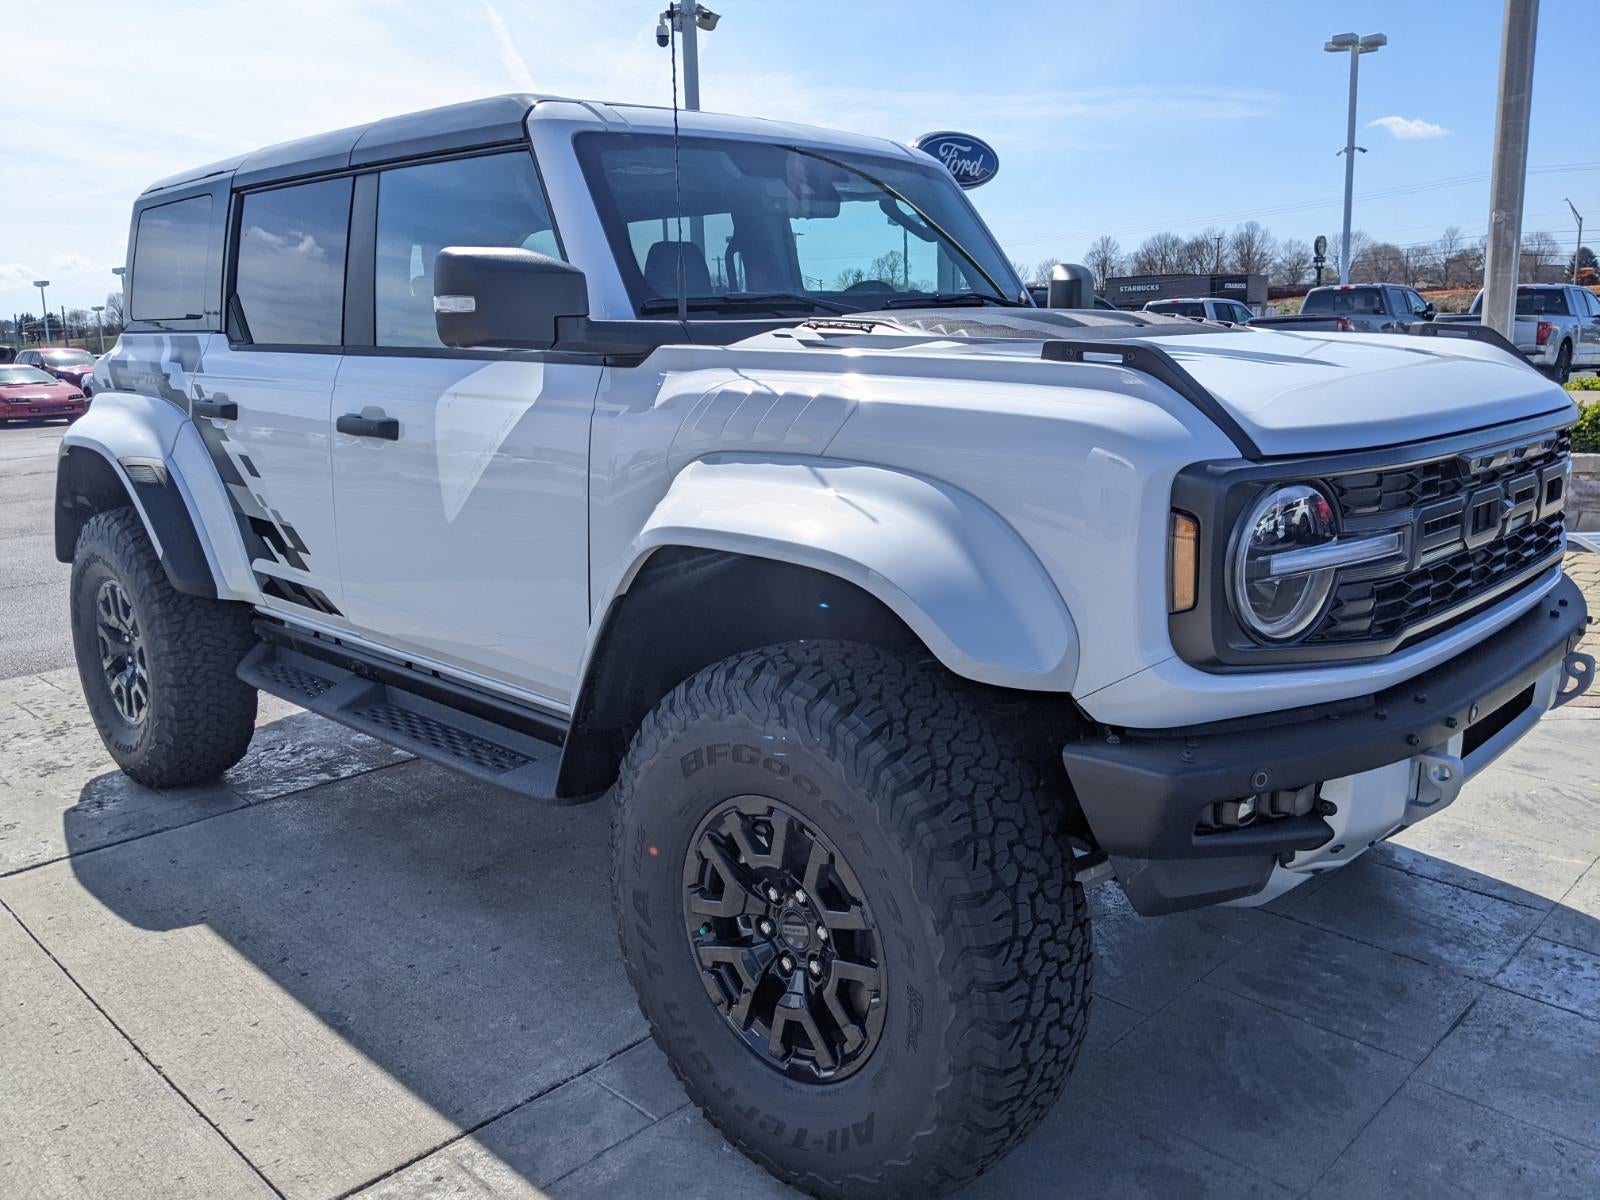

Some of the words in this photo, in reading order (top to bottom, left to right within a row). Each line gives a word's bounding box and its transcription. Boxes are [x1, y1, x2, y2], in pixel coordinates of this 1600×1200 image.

[938, 142, 988, 177] Ford
[1120, 284, 1160, 293] STARBUCKS
[1412, 459, 1568, 570] FORD
